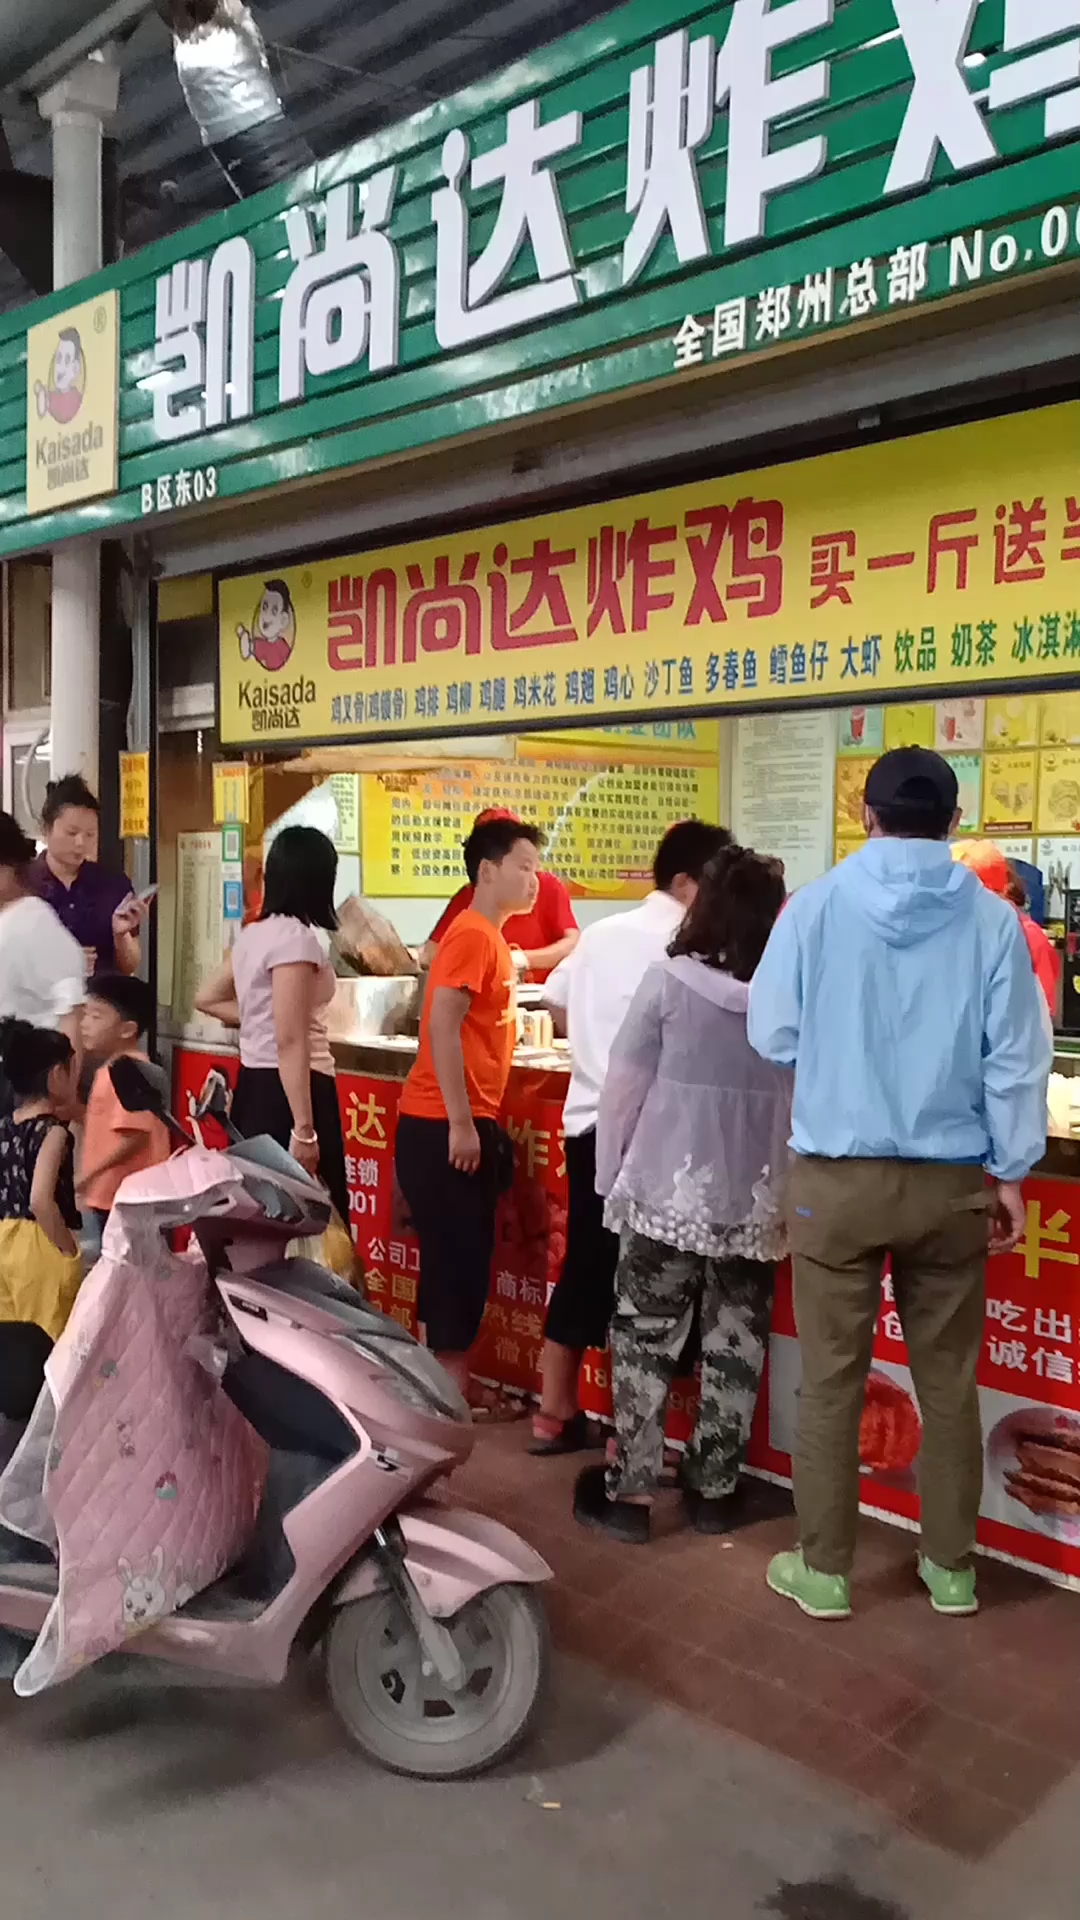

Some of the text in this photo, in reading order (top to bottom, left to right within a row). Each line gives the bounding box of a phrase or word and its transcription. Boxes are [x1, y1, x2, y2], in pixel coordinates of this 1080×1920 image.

[672, 205, 1080, 370] 全国郑州总部 No.0
[36, 421, 104, 469] Kaisada
[141, 466, 217, 514] B区东03
[327, 496, 785, 672] 凯尚达炸鸡
[238, 674, 316, 710] Kaisada
[415, 684, 440, 718] 鸡排
[446, 680, 473, 715] 鸡柳
[479, 676, 506, 712] 鸡腿
[513, 671, 557, 709] 鸡米花
[565, 668, 596, 705] 鸡翅
[603, 664, 635, 701] 鸡心
[644, 655, 694, 698] 沙丁鱼
[706, 647, 758, 694] 多春鱼
[769, 639, 830, 686] 鳕鱼仔
[840, 633, 883, 680] 大虾
[894, 624, 937, 672] 饮品
[950, 619, 998, 667] 奶茶
[251, 706, 300, 732] 凯尚达
[344, 1091, 567, 1178] 达 炸
[1012, 1200, 1079, 1279] 半
[364, 1268, 416, 1303] 全国
[496, 1270, 556, 1307] 商标
[986, 1299, 1080, 1343] 吃出
[986, 1336, 1080, 1385] 诚信
